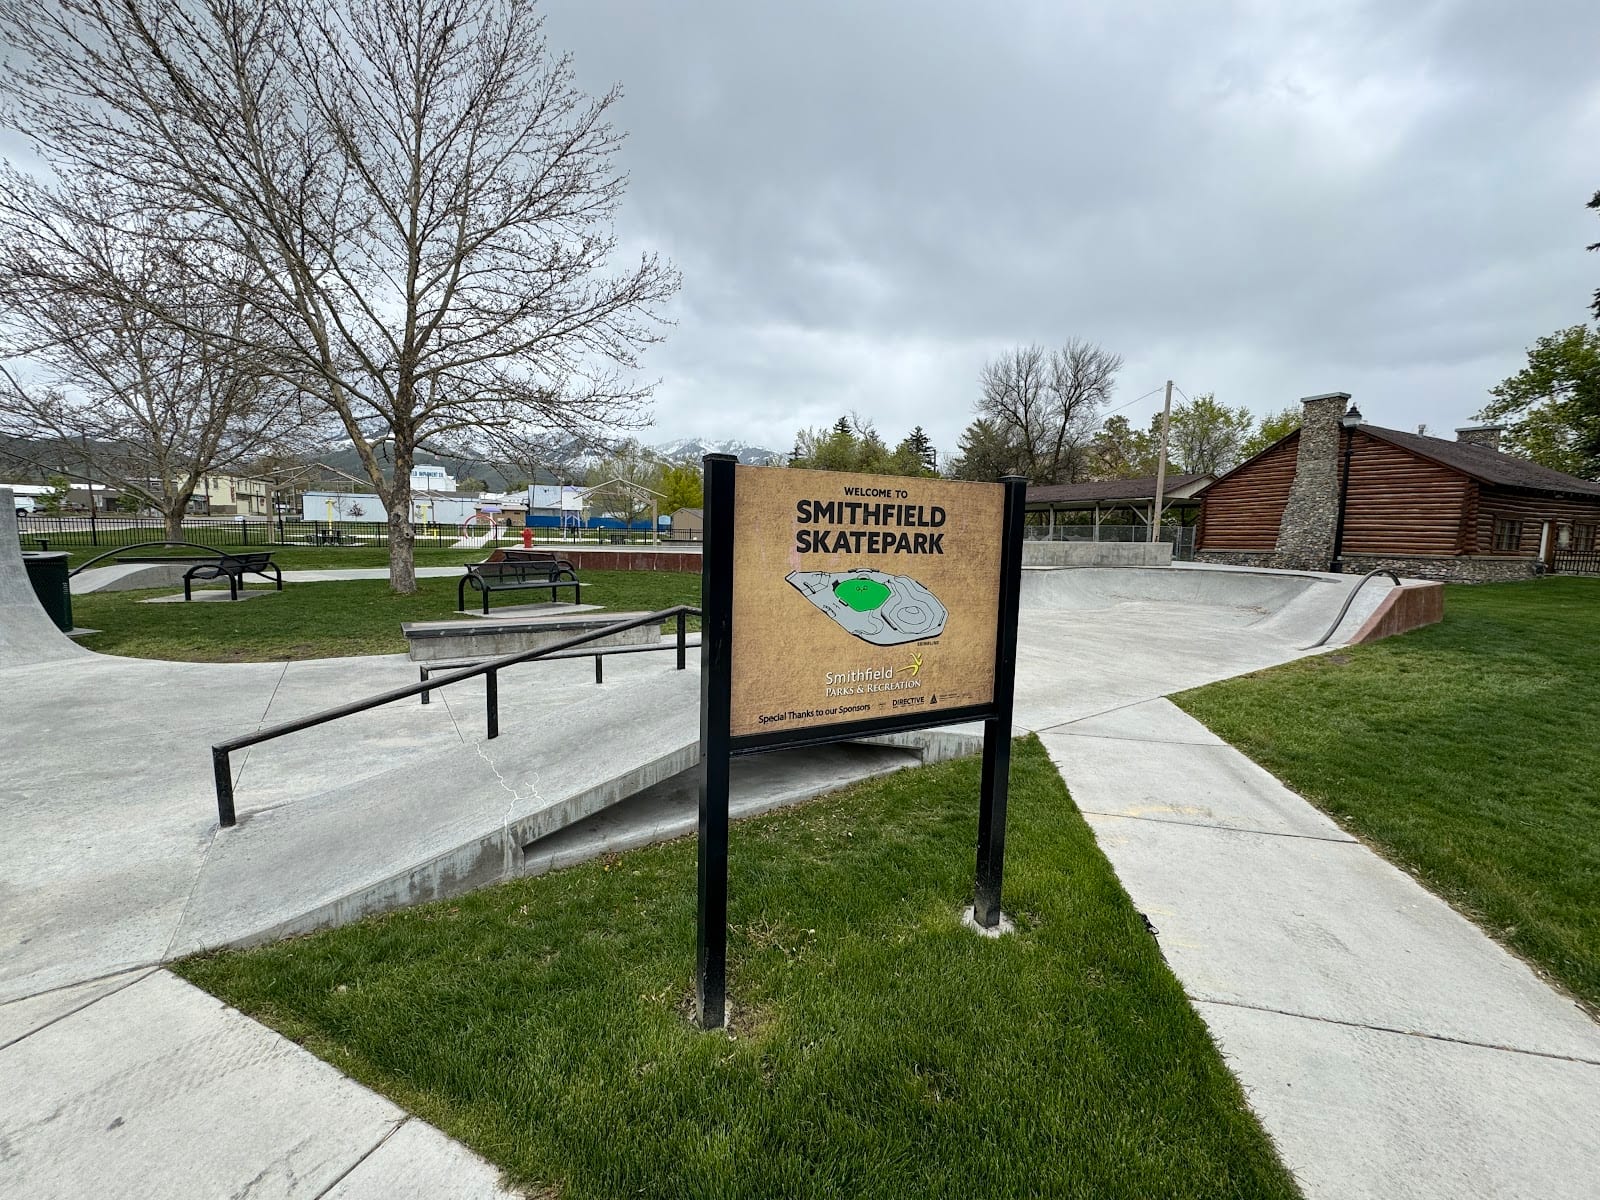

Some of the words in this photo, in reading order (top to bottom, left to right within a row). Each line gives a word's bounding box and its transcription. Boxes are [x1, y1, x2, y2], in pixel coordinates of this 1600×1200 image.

[844, 487, 892, 498] WELCOME
[895, 490, 908, 498] TO
[796, 500, 946, 527] SMITHFIELD
[796, 530, 944, 554] SKATEPARK
[826, 666, 893, 684] Smithfield
[826, 687, 854, 698] PARKS
[856, 686, 864, 694] &
[867, 680, 921, 692] RECREATION
[892, 696, 924, 706] DIRECTIVE
[758, 712, 786, 724] Special
[788, 710, 814, 720] Thanks
[838, 704, 870, 714] Sponsors
